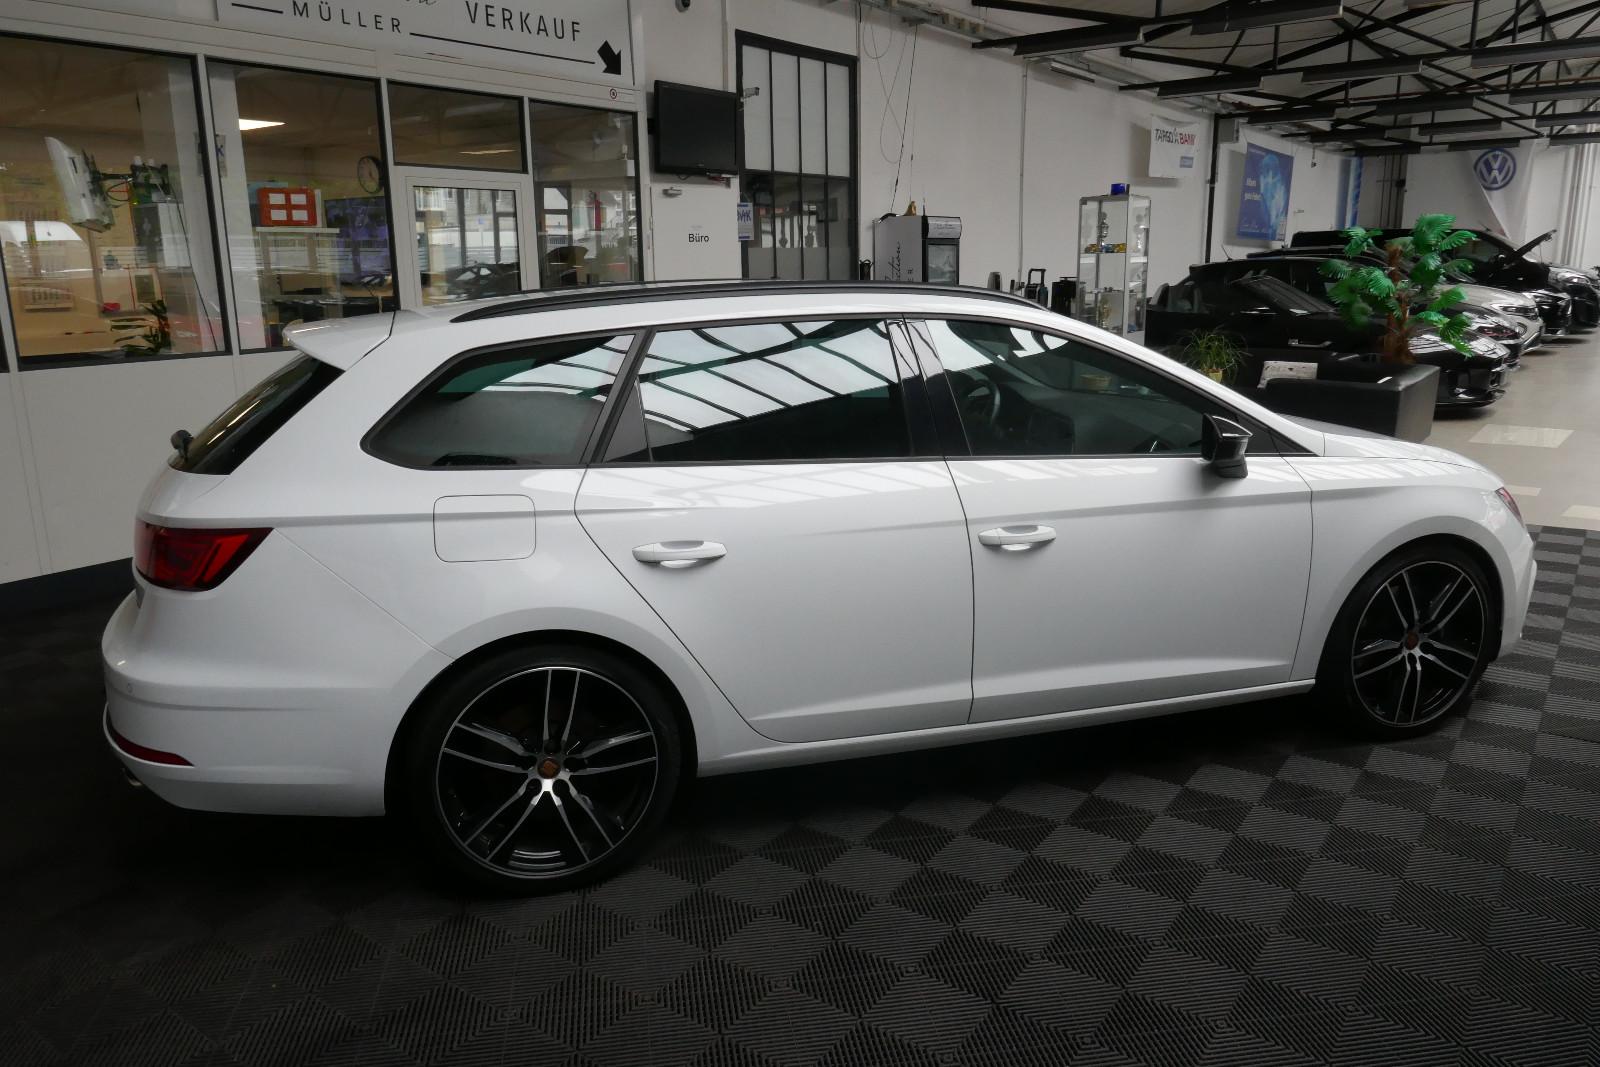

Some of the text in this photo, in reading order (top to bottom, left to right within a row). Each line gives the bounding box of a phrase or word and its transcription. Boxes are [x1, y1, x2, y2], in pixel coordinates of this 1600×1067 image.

[293, 0, 402, 33] MÜLLER
[465, 1, 582, 41] VERKAUF
[688, 233, 709, 243] Büro
